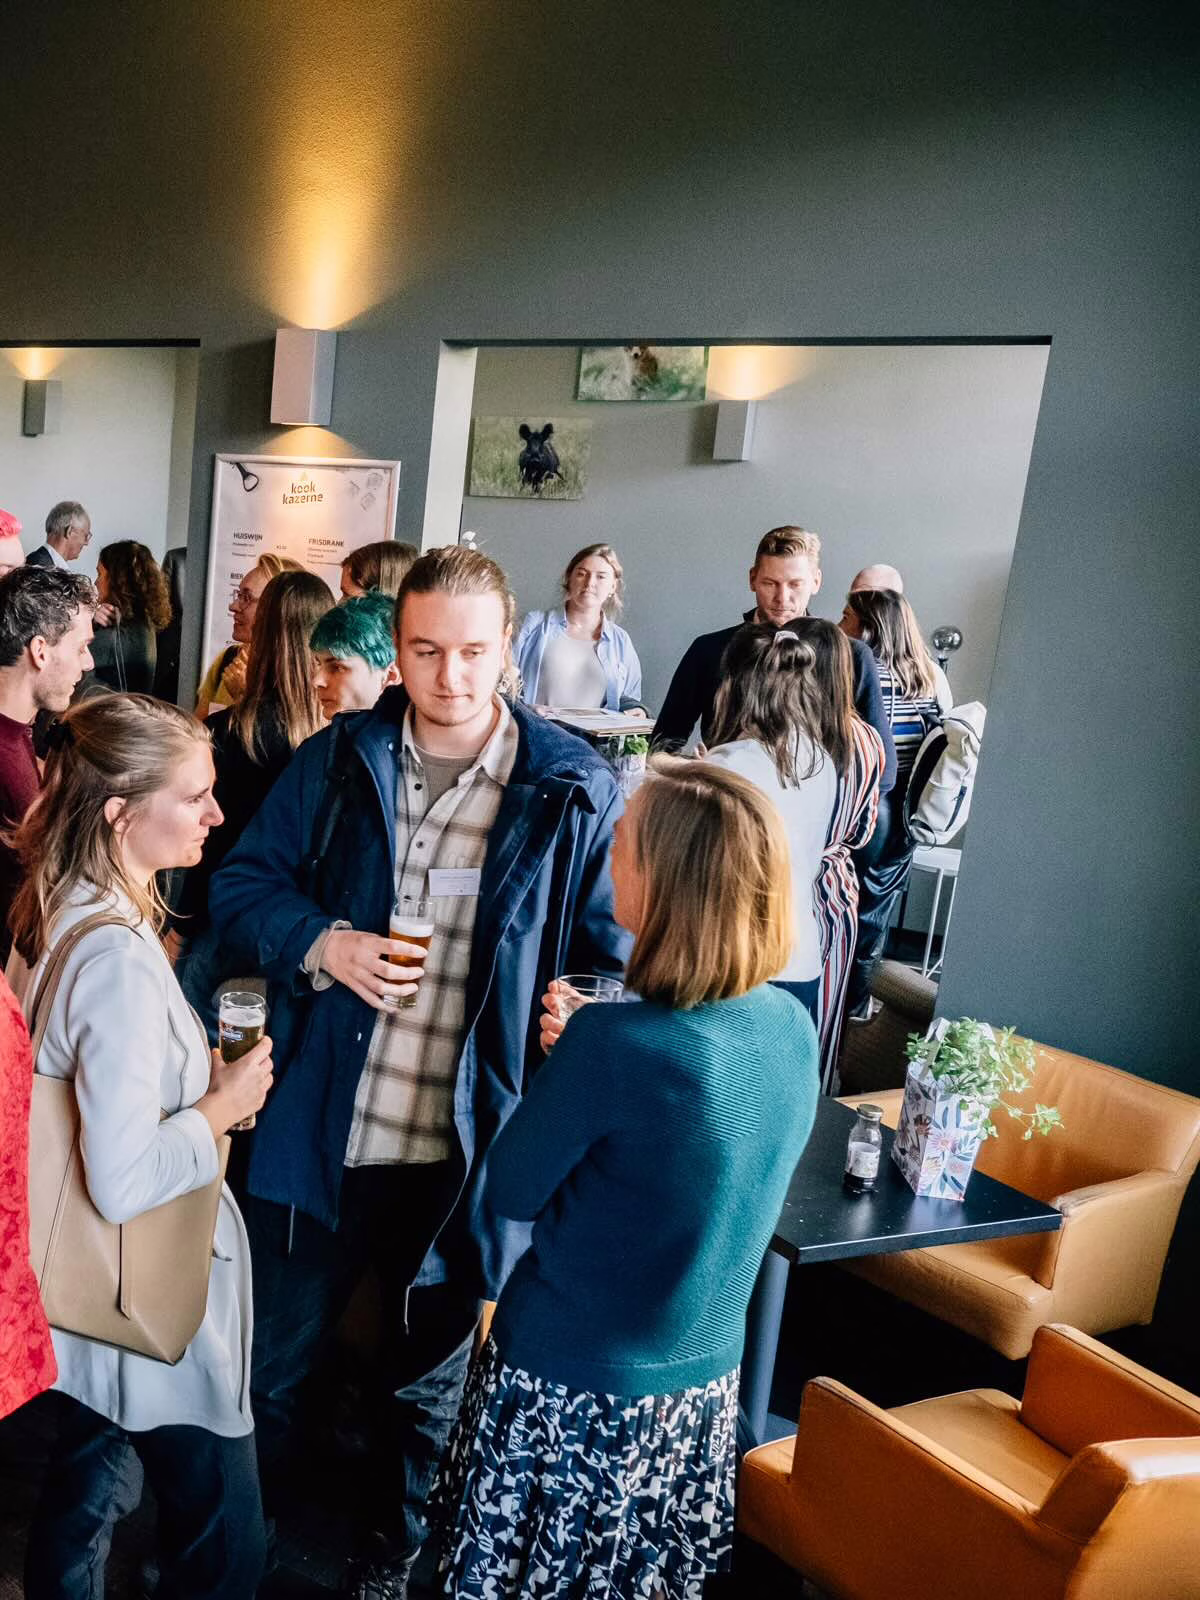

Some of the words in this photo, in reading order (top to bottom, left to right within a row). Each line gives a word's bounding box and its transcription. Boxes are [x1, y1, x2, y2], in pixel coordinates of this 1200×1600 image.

[291, 481, 315, 494] kook
[282, 493, 324, 505] kazerne
[308, 538, 344, 547] FRISDRANK
